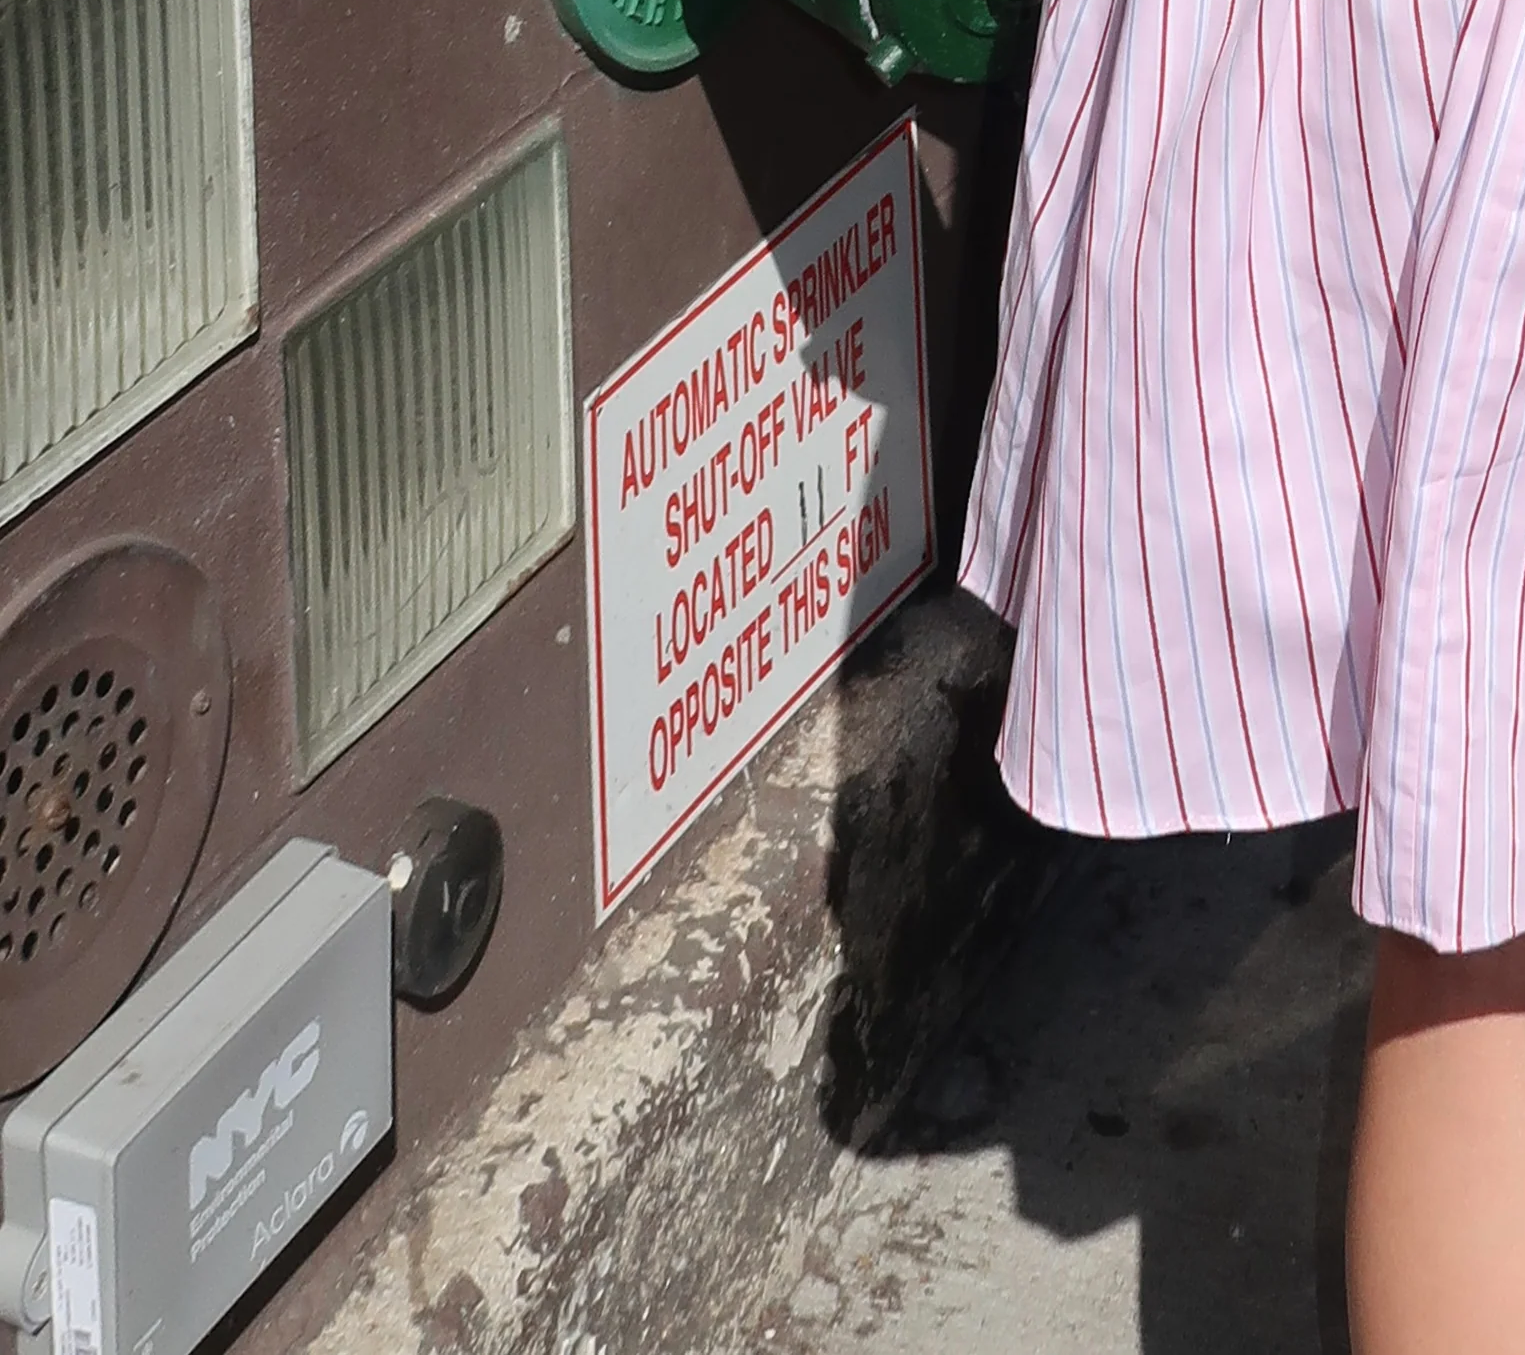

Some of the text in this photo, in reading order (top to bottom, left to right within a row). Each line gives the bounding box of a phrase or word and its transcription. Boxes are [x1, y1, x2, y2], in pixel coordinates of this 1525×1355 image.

[621, 192, 897, 511] AUTOMATIC SPRINKLER
[665, 317, 866, 568] SHUT-OFF VALVE
[649, 486, 891, 791] OPPOSITE THIS SIGN
[655, 507, 774, 685] LOCATED
[845, 403, 879, 492] FT.
[189, 1018, 320, 1211] NYC
[250, 1152, 334, 1262] Aclara
